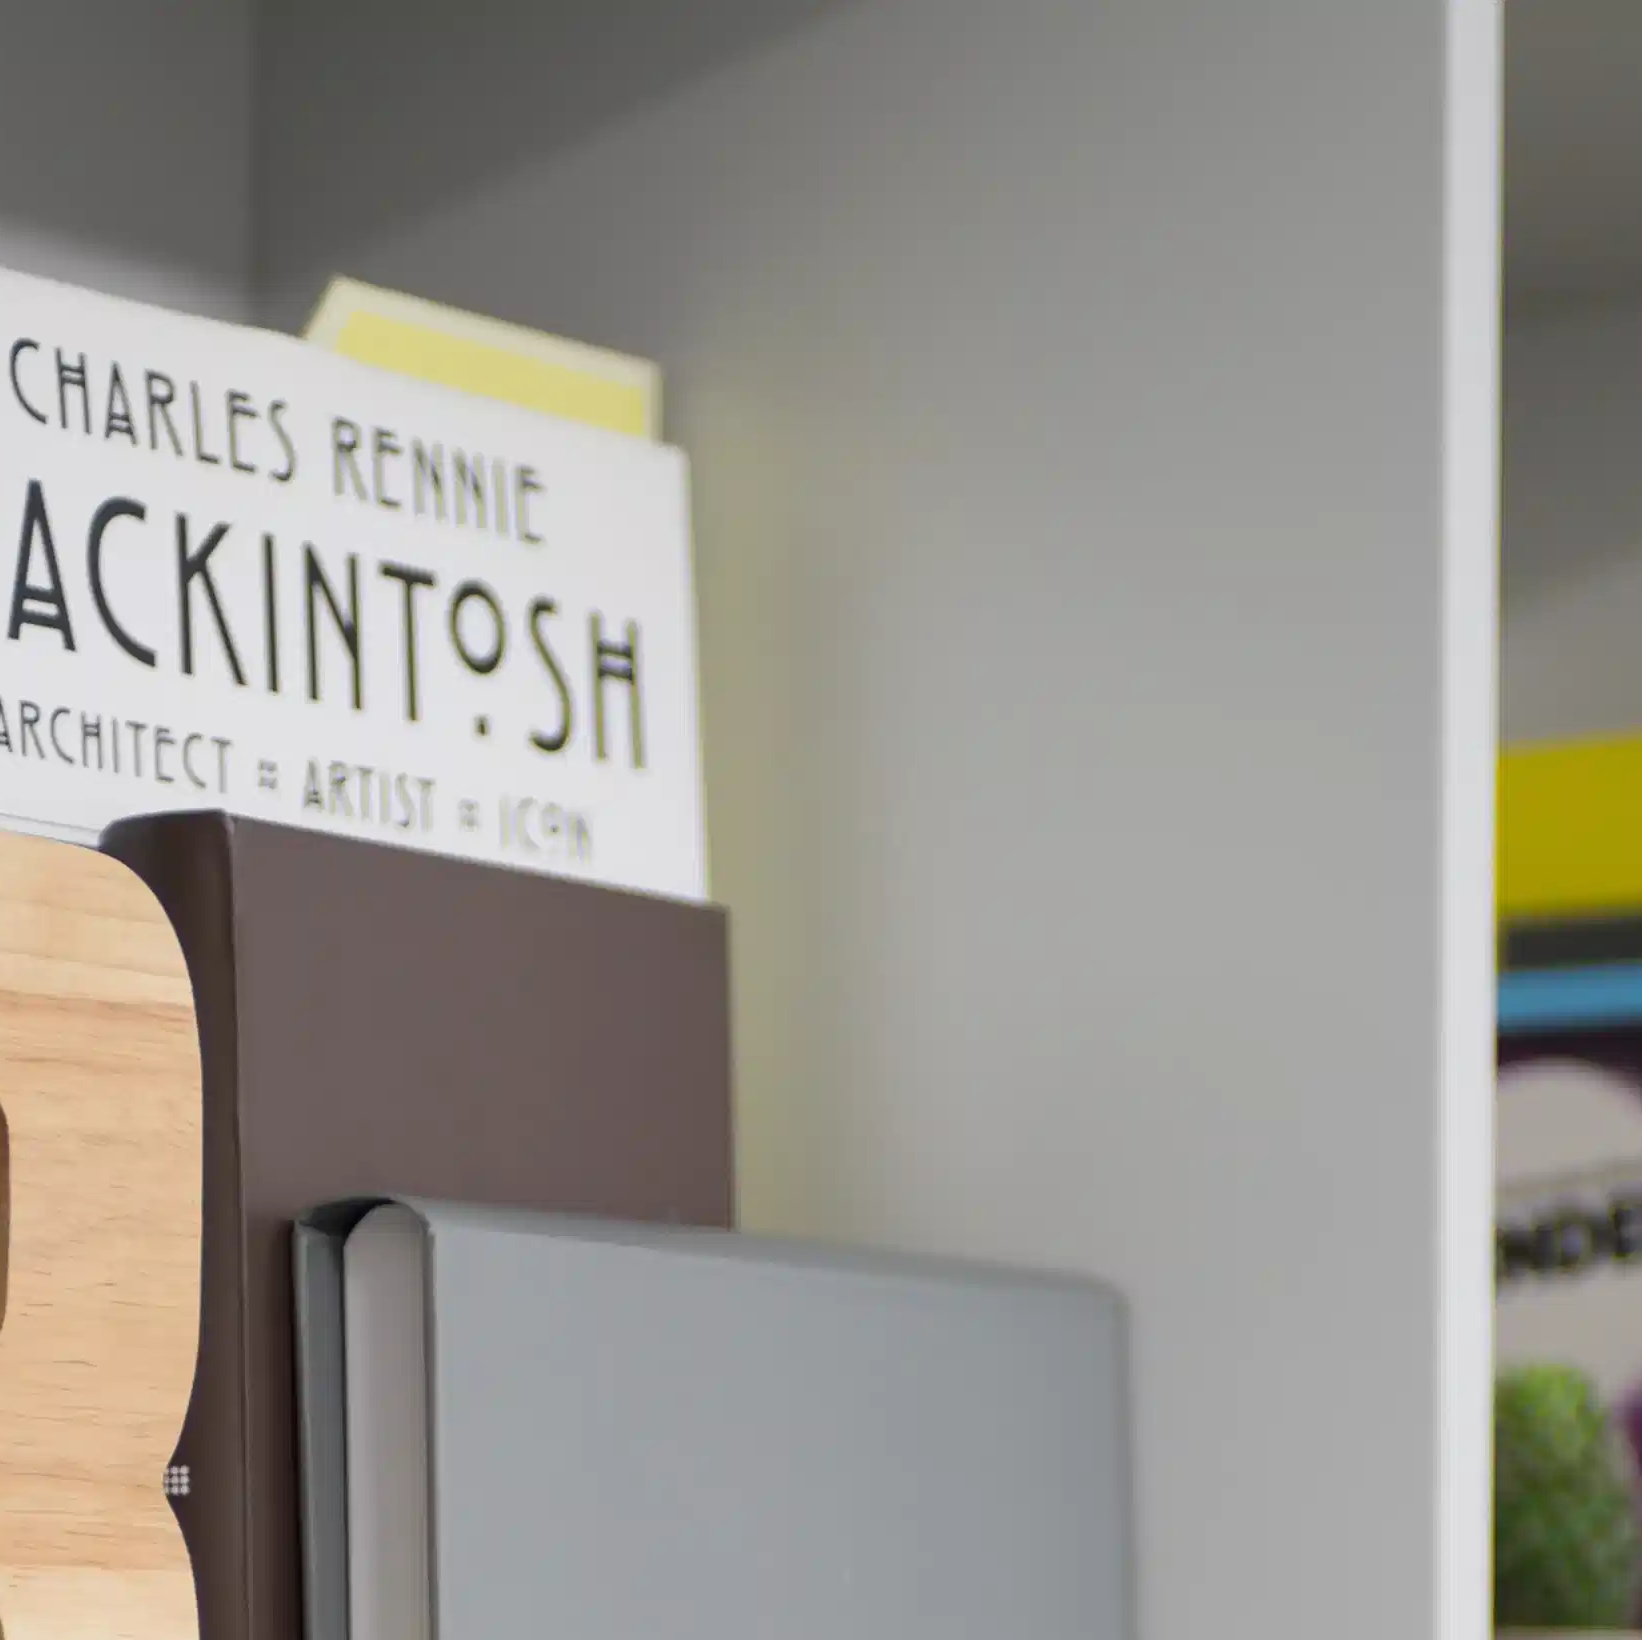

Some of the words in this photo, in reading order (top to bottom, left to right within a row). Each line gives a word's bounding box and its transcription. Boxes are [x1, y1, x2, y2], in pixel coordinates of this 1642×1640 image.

[10, 337, 296, 483] CHARLES
[331, 415, 545, 546] RENNIE
[302, 756, 435, 832] ARTIST
[499, 796, 593, 866] ICON
